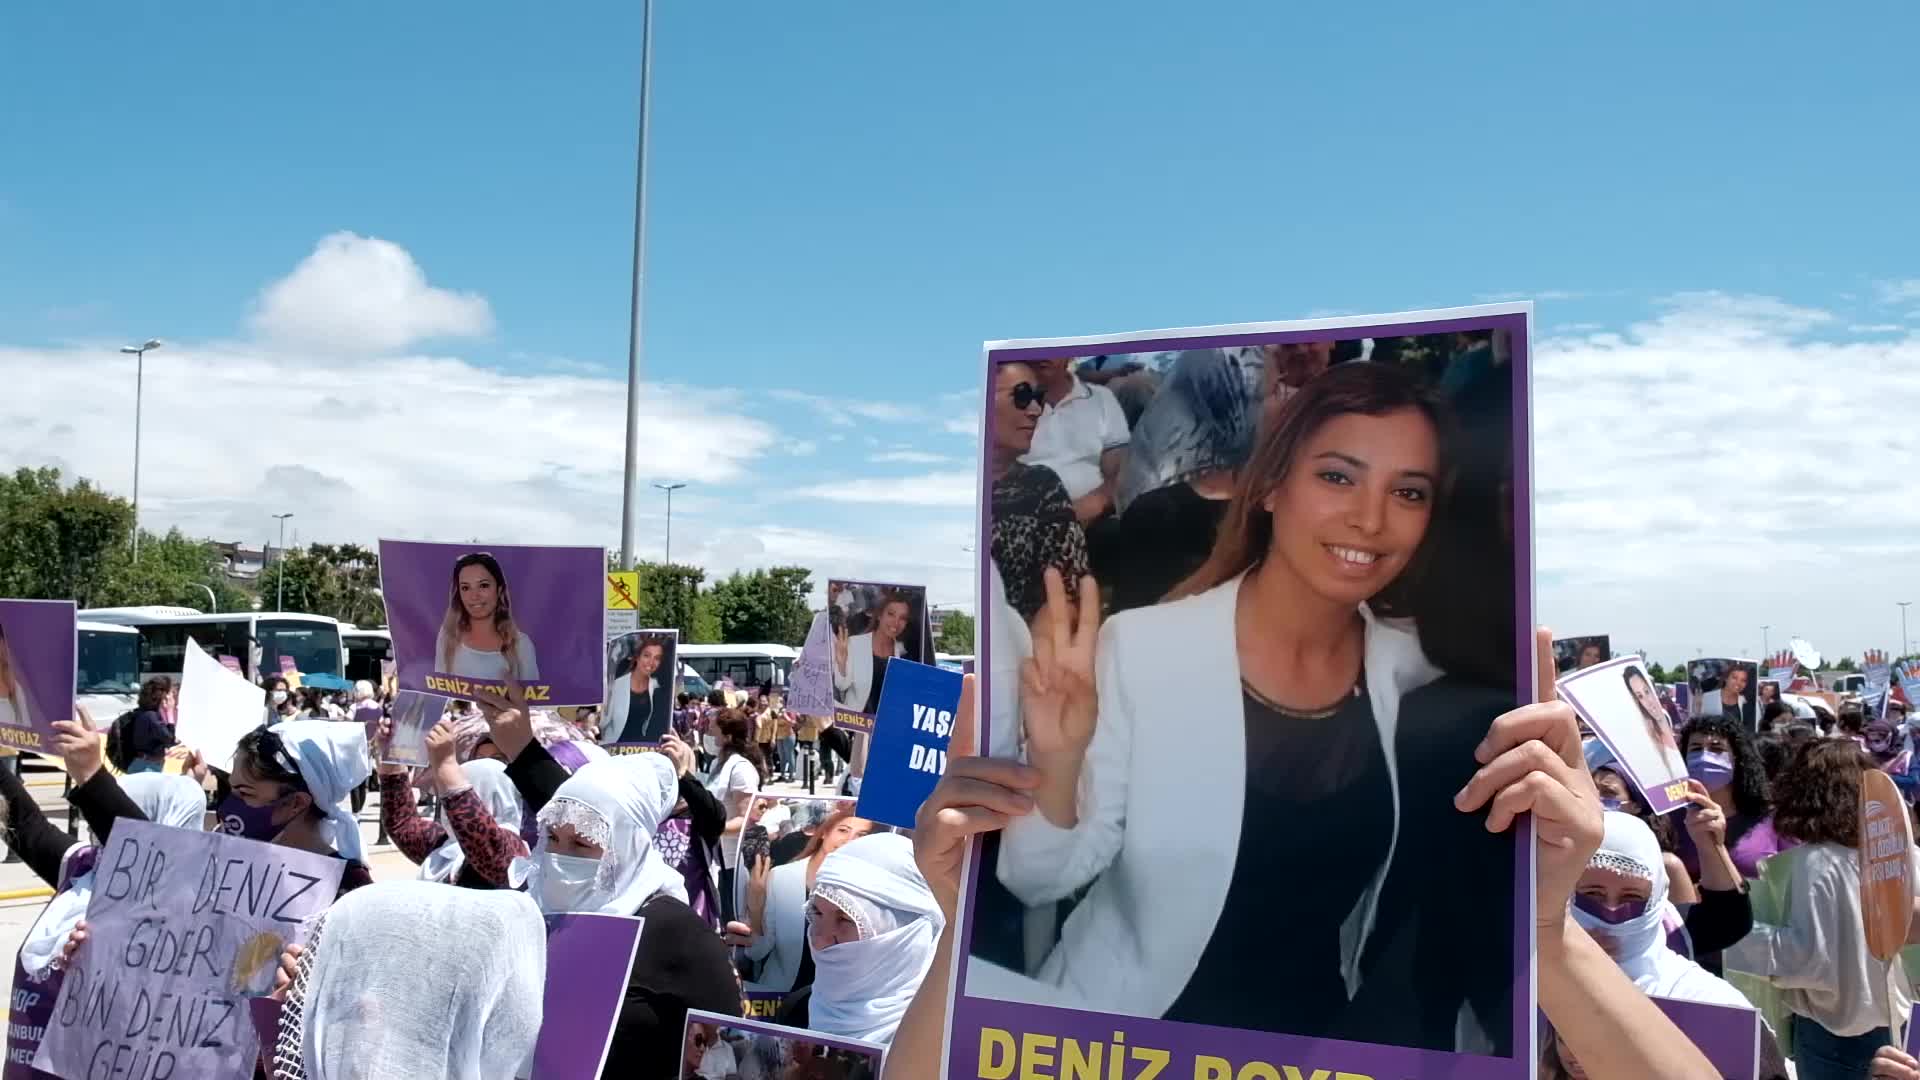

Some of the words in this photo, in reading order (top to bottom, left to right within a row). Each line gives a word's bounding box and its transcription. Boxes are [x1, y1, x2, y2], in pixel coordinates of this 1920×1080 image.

[425, 675, 472, 696] DENİZ
[836, 711, 865, 726] DENİZ
[105, 837, 166, 911] BİR
[192, 853, 322, 924] DENİZ
[125, 916, 220, 977] GİDER
[61, 966, 120, 1031] BİN
[126, 987, 236, 1049] DENİZ
[741, 996, 784, 1018] DEN
[977, 1026, 1171, 1080] DENİZ
